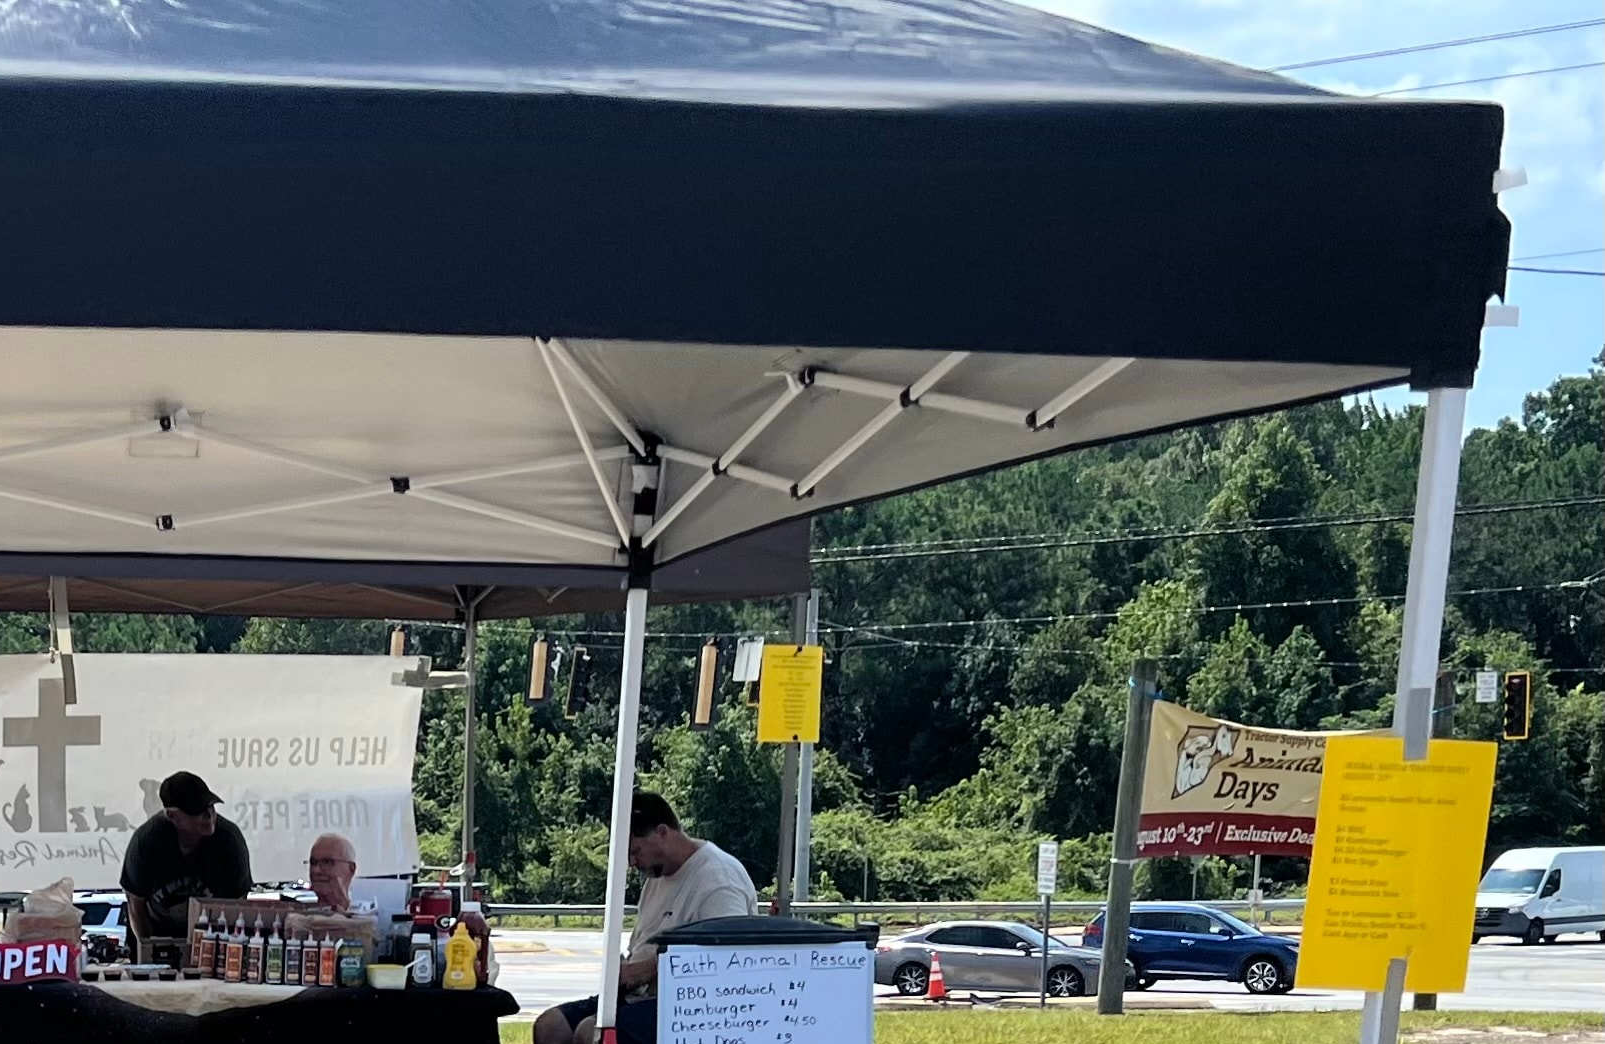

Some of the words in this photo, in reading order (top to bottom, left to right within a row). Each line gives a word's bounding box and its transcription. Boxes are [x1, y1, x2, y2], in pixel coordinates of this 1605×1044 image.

[1245, 731, 1279, 743] Tractor
[1280, 734, 1313, 748] Supply
[1214, 771, 1279, 808] Days
[1137, 827, 1162, 850] ugust
[1224, 825, 1287, 843] Exclusive
[1288, 828, 1315, 844] Dea
[669, 952, 718, 977] Faith
[726, 952, 798, 971] Animal
[810, 950, 867, 968] Rescue
[676, 986, 707, 1001] BBQ
[673, 1003, 756, 1019] Hamburger
[671, 1018, 770, 1033] Cheeseburger
